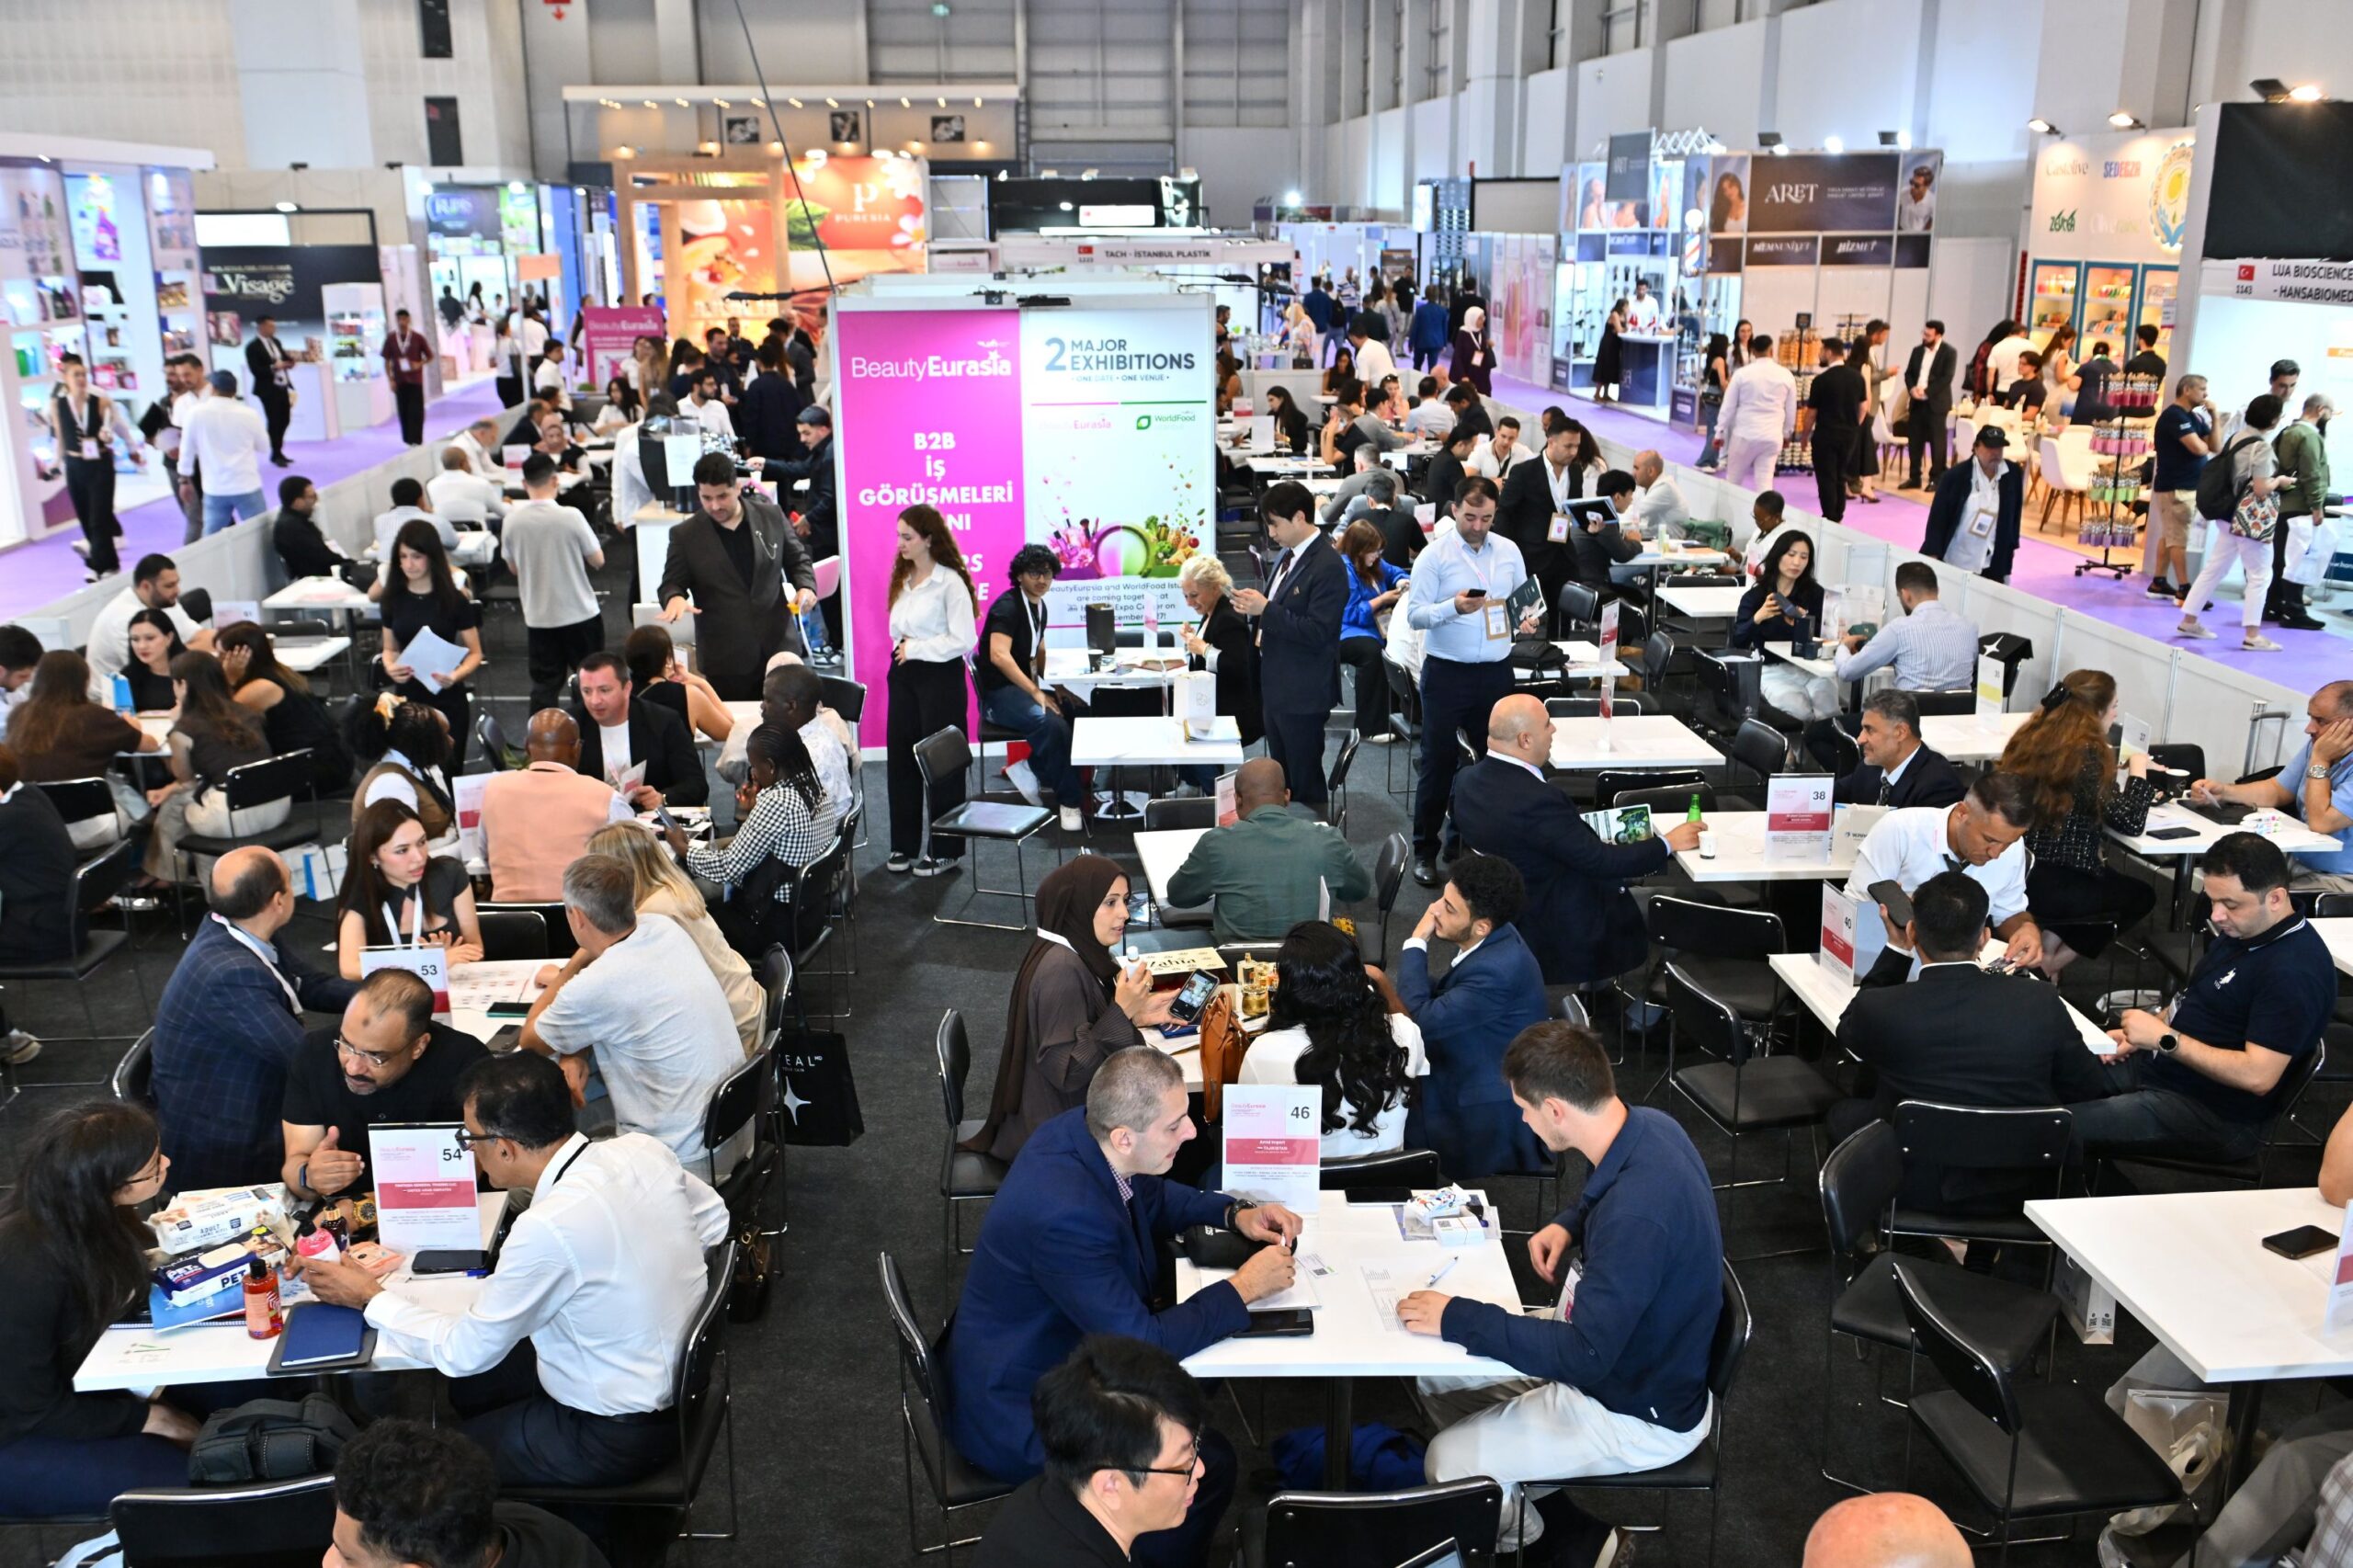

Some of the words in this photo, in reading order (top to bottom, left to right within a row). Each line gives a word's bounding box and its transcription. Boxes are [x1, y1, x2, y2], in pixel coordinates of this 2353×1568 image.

[1765, 183, 1819, 204] ARET
[835, 213, 891, 223] PURESIA
[1105, 250, 1127, 258] TACH
[1134, 248, 1174, 258] İSTANBUL
[2272, 264, 2291, 277] LUA
[222, 274, 294, 304] Visage
[2235, 285, 2253, 295] 1143
[1071, 339, 1127, 352] MAJOR
[1045, 336, 1066, 371] 2
[851, 350, 1012, 382] BeautyEurasia
[1071, 353, 1195, 371] EXHIBITIONS
[1154, 414, 1196, 423] WorldFood
[914, 432, 956, 450] B2B
[926, 455, 946, 483] İŞ
[858, 480, 1013, 507] GÖRÜŞMELERİ
[1123, 582, 1165, 590] WorldFood
[1813, 791, 1825, 801] 38
[1844, 916, 1851, 929] 40
[421, 965, 438, 976] 53
[1290, 1107, 1310, 1119] 46
[443, 1149, 462, 1162] 54
[221, 1269, 246, 1289] PET
